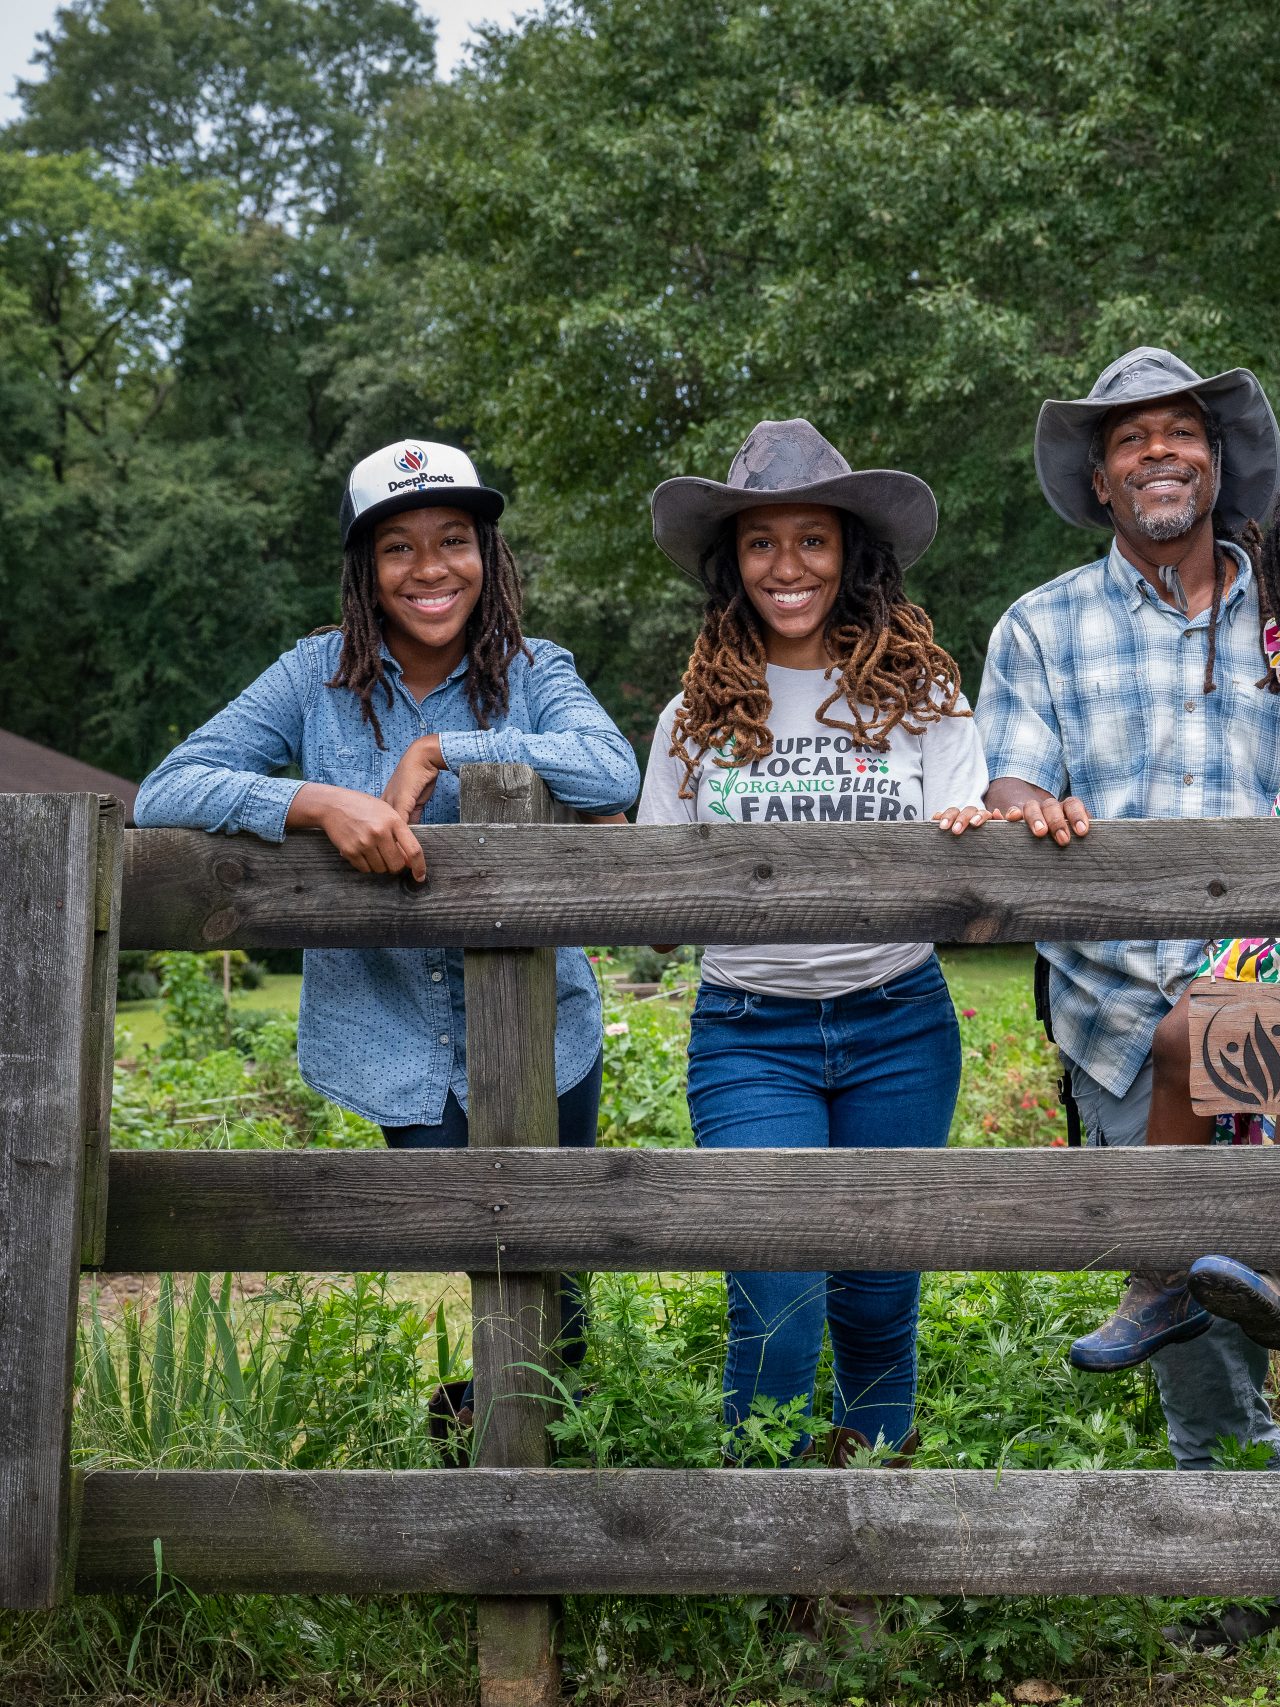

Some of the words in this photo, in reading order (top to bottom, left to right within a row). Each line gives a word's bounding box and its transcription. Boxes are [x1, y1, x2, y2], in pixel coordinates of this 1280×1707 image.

[388, 473, 454, 492] DeepRoots
[750, 757, 851, 777] LOCAL
[734, 779, 835, 794] ORGANIC
[839, 777, 901, 796] BLACK
